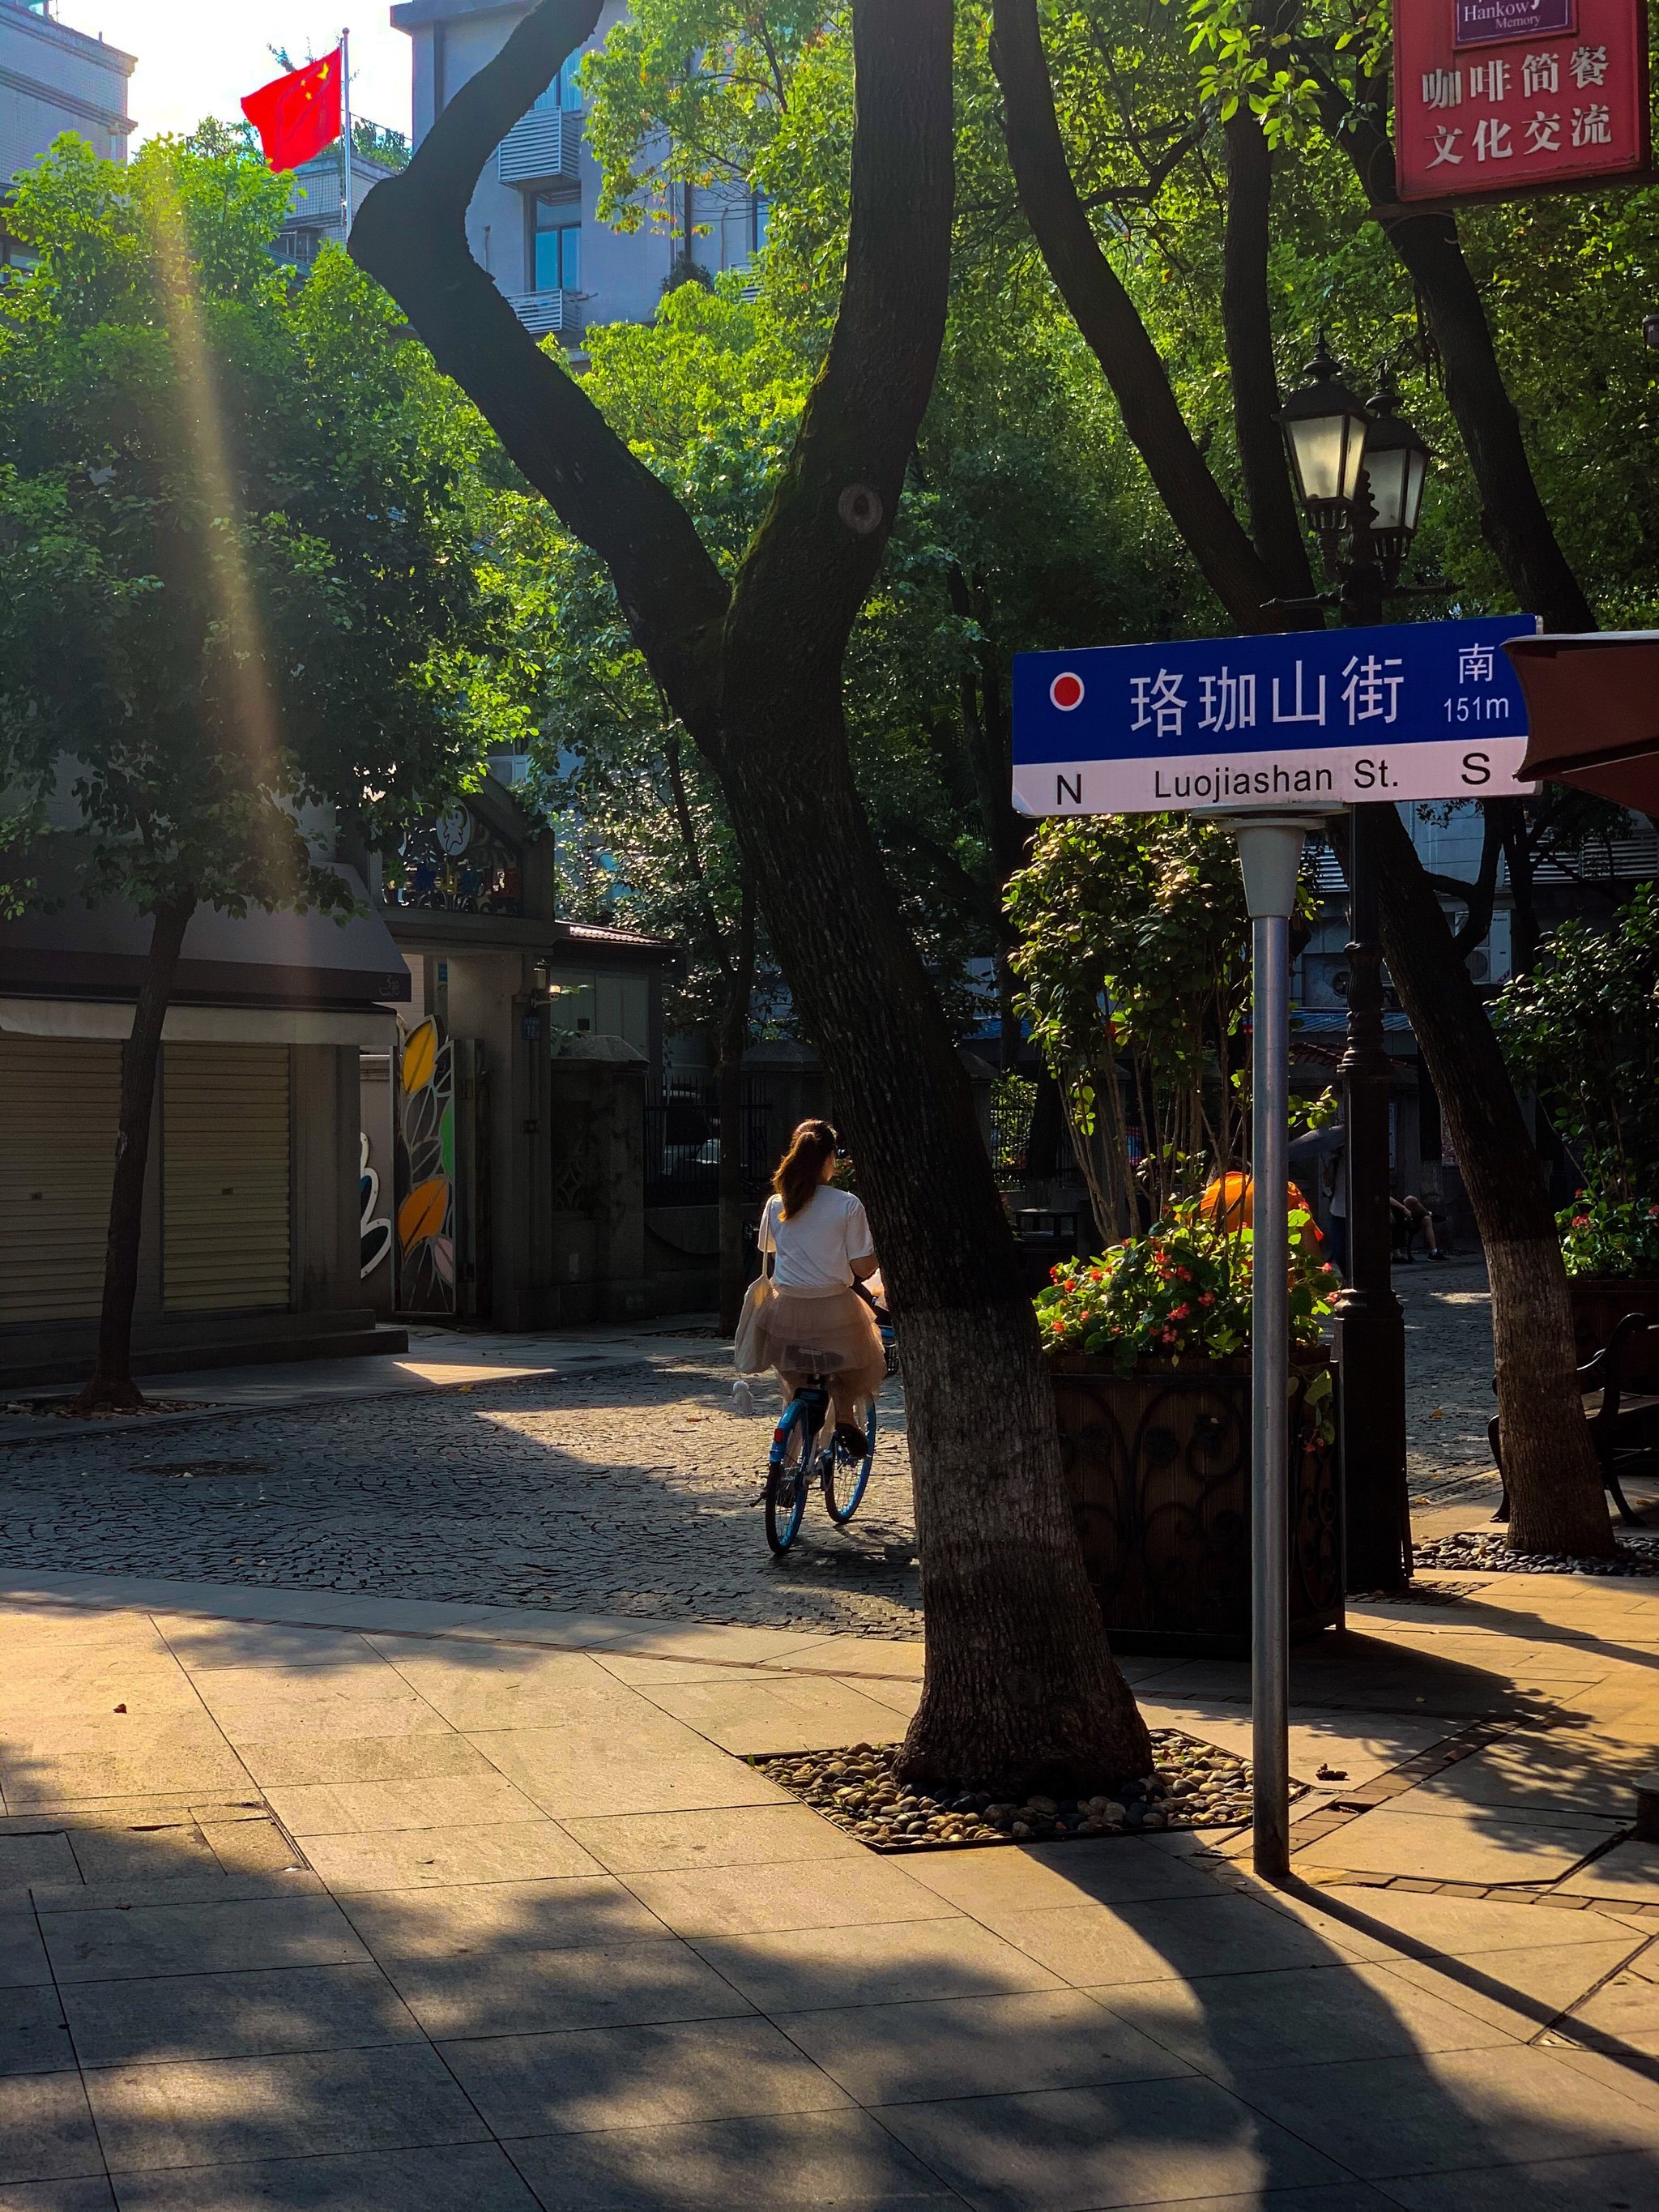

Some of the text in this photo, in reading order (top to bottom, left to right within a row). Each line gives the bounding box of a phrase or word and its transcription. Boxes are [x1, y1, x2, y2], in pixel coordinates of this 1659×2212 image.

[1464, 1, 1529, 22] Hankow
[1495, 15, 1542, 29] Memory
[1422, 45, 1610, 111] 咖啡简餐
[1424, 103, 1612, 170] 文化交流
[1458, 643, 1495, 684] 南
[1129, 655, 1405, 737] 珞珈山街
[1444, 696, 1509, 722] 151m
[1154, 759, 1398, 803] Luojiashan St.
[1461, 752, 1491, 784] S
[1056, 773, 1082, 805] N
